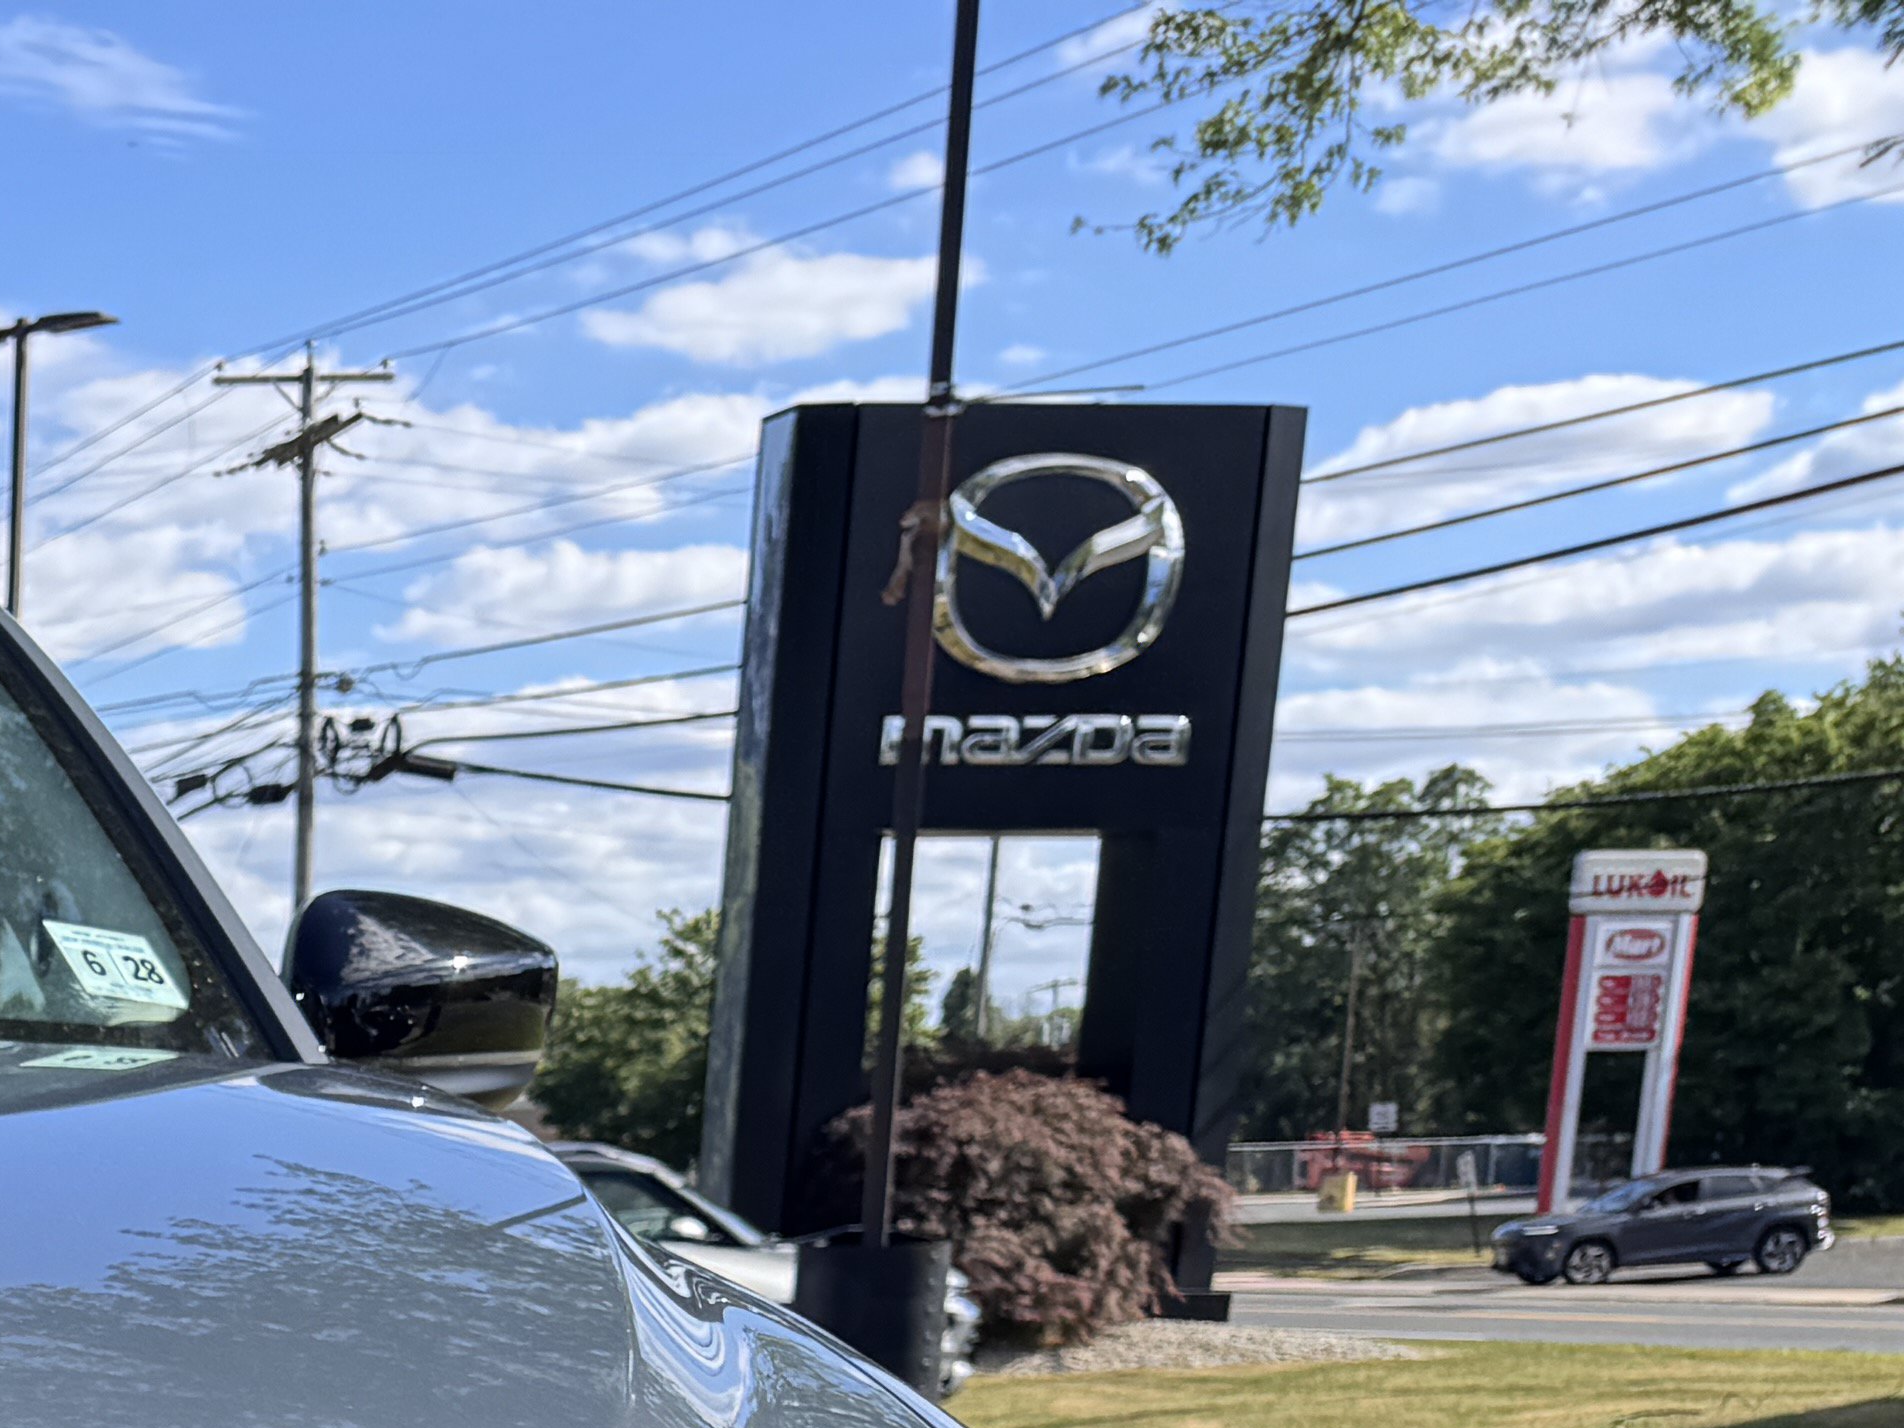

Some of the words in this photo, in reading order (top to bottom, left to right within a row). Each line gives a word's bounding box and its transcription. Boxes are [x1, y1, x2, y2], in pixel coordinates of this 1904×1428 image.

[878, 713, 1192, 766] mazda
[82, 950, 108, 977] 6
[121, 954, 165, 985] 28
